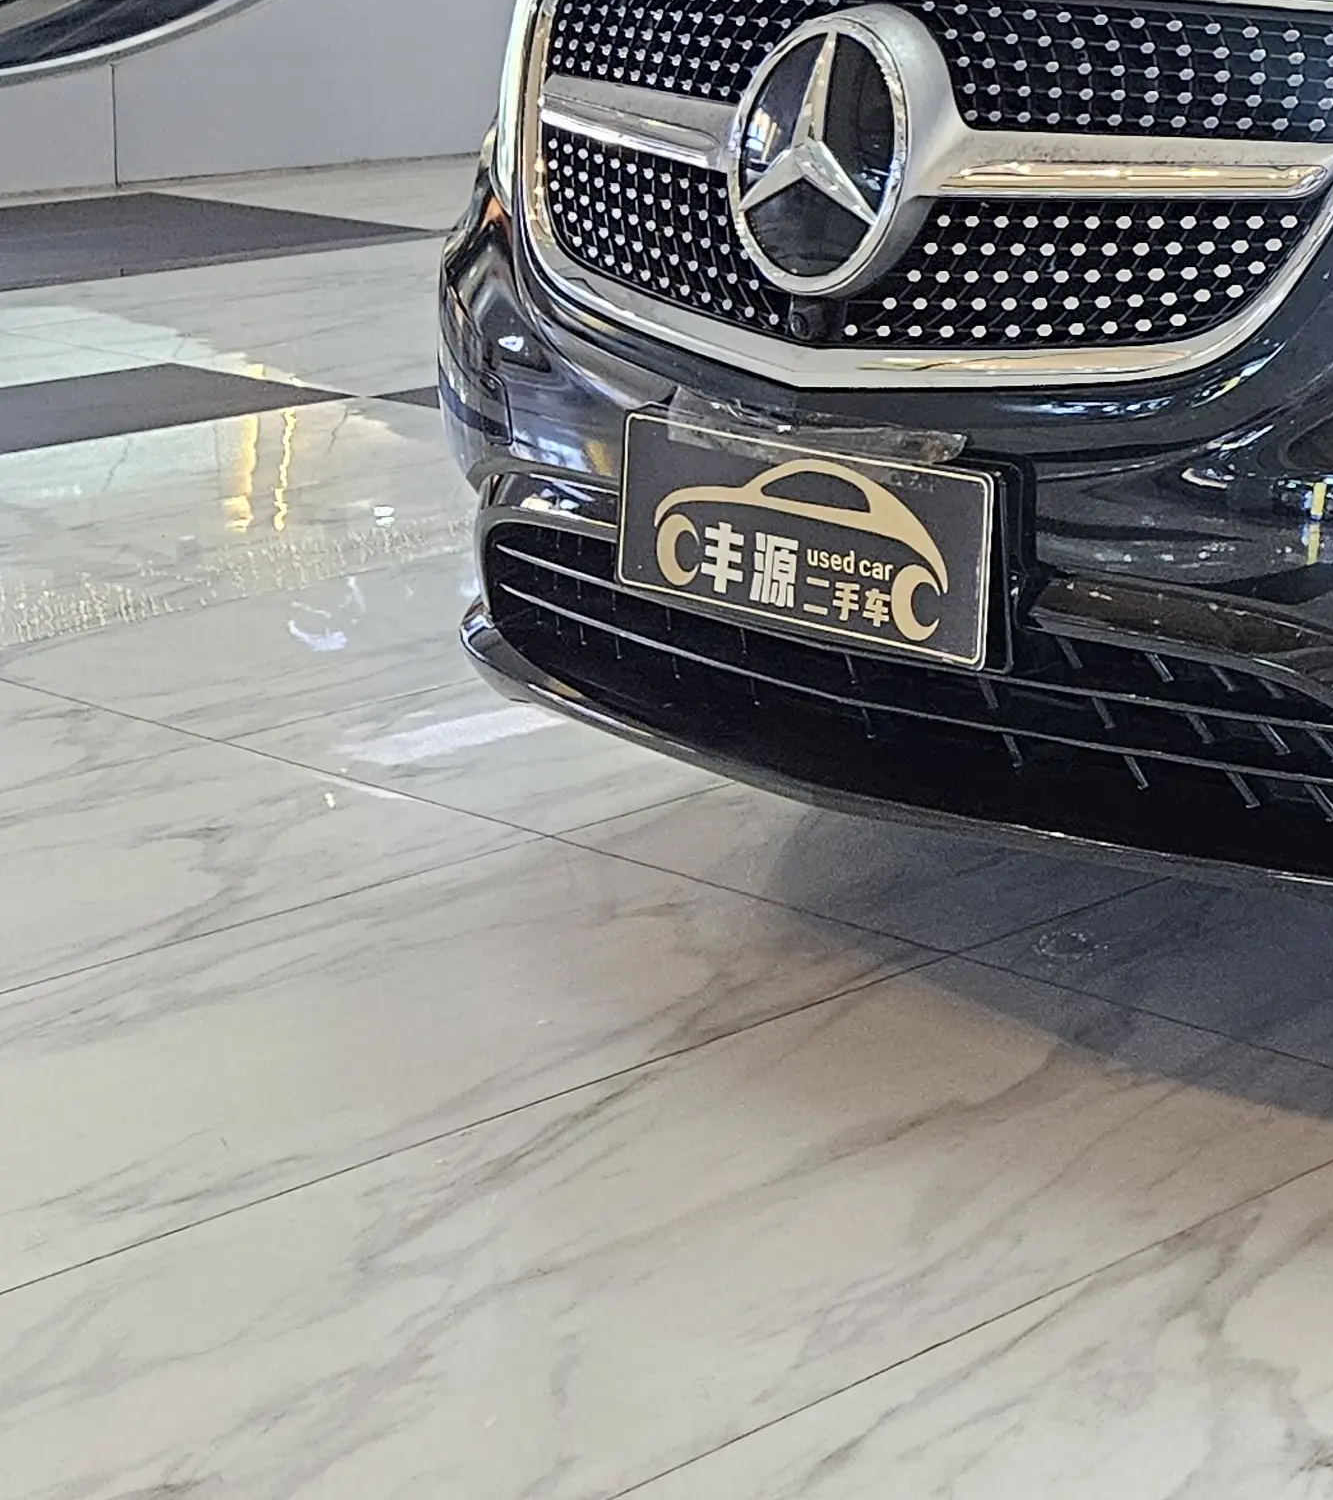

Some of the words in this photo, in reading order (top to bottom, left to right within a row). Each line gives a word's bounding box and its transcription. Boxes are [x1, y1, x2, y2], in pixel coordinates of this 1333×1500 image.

[700, 520, 799, 610] 丰源
[806, 547, 855, 575] used
[859, 558, 896, 582] car
[802, 576, 892, 628] 二手车
